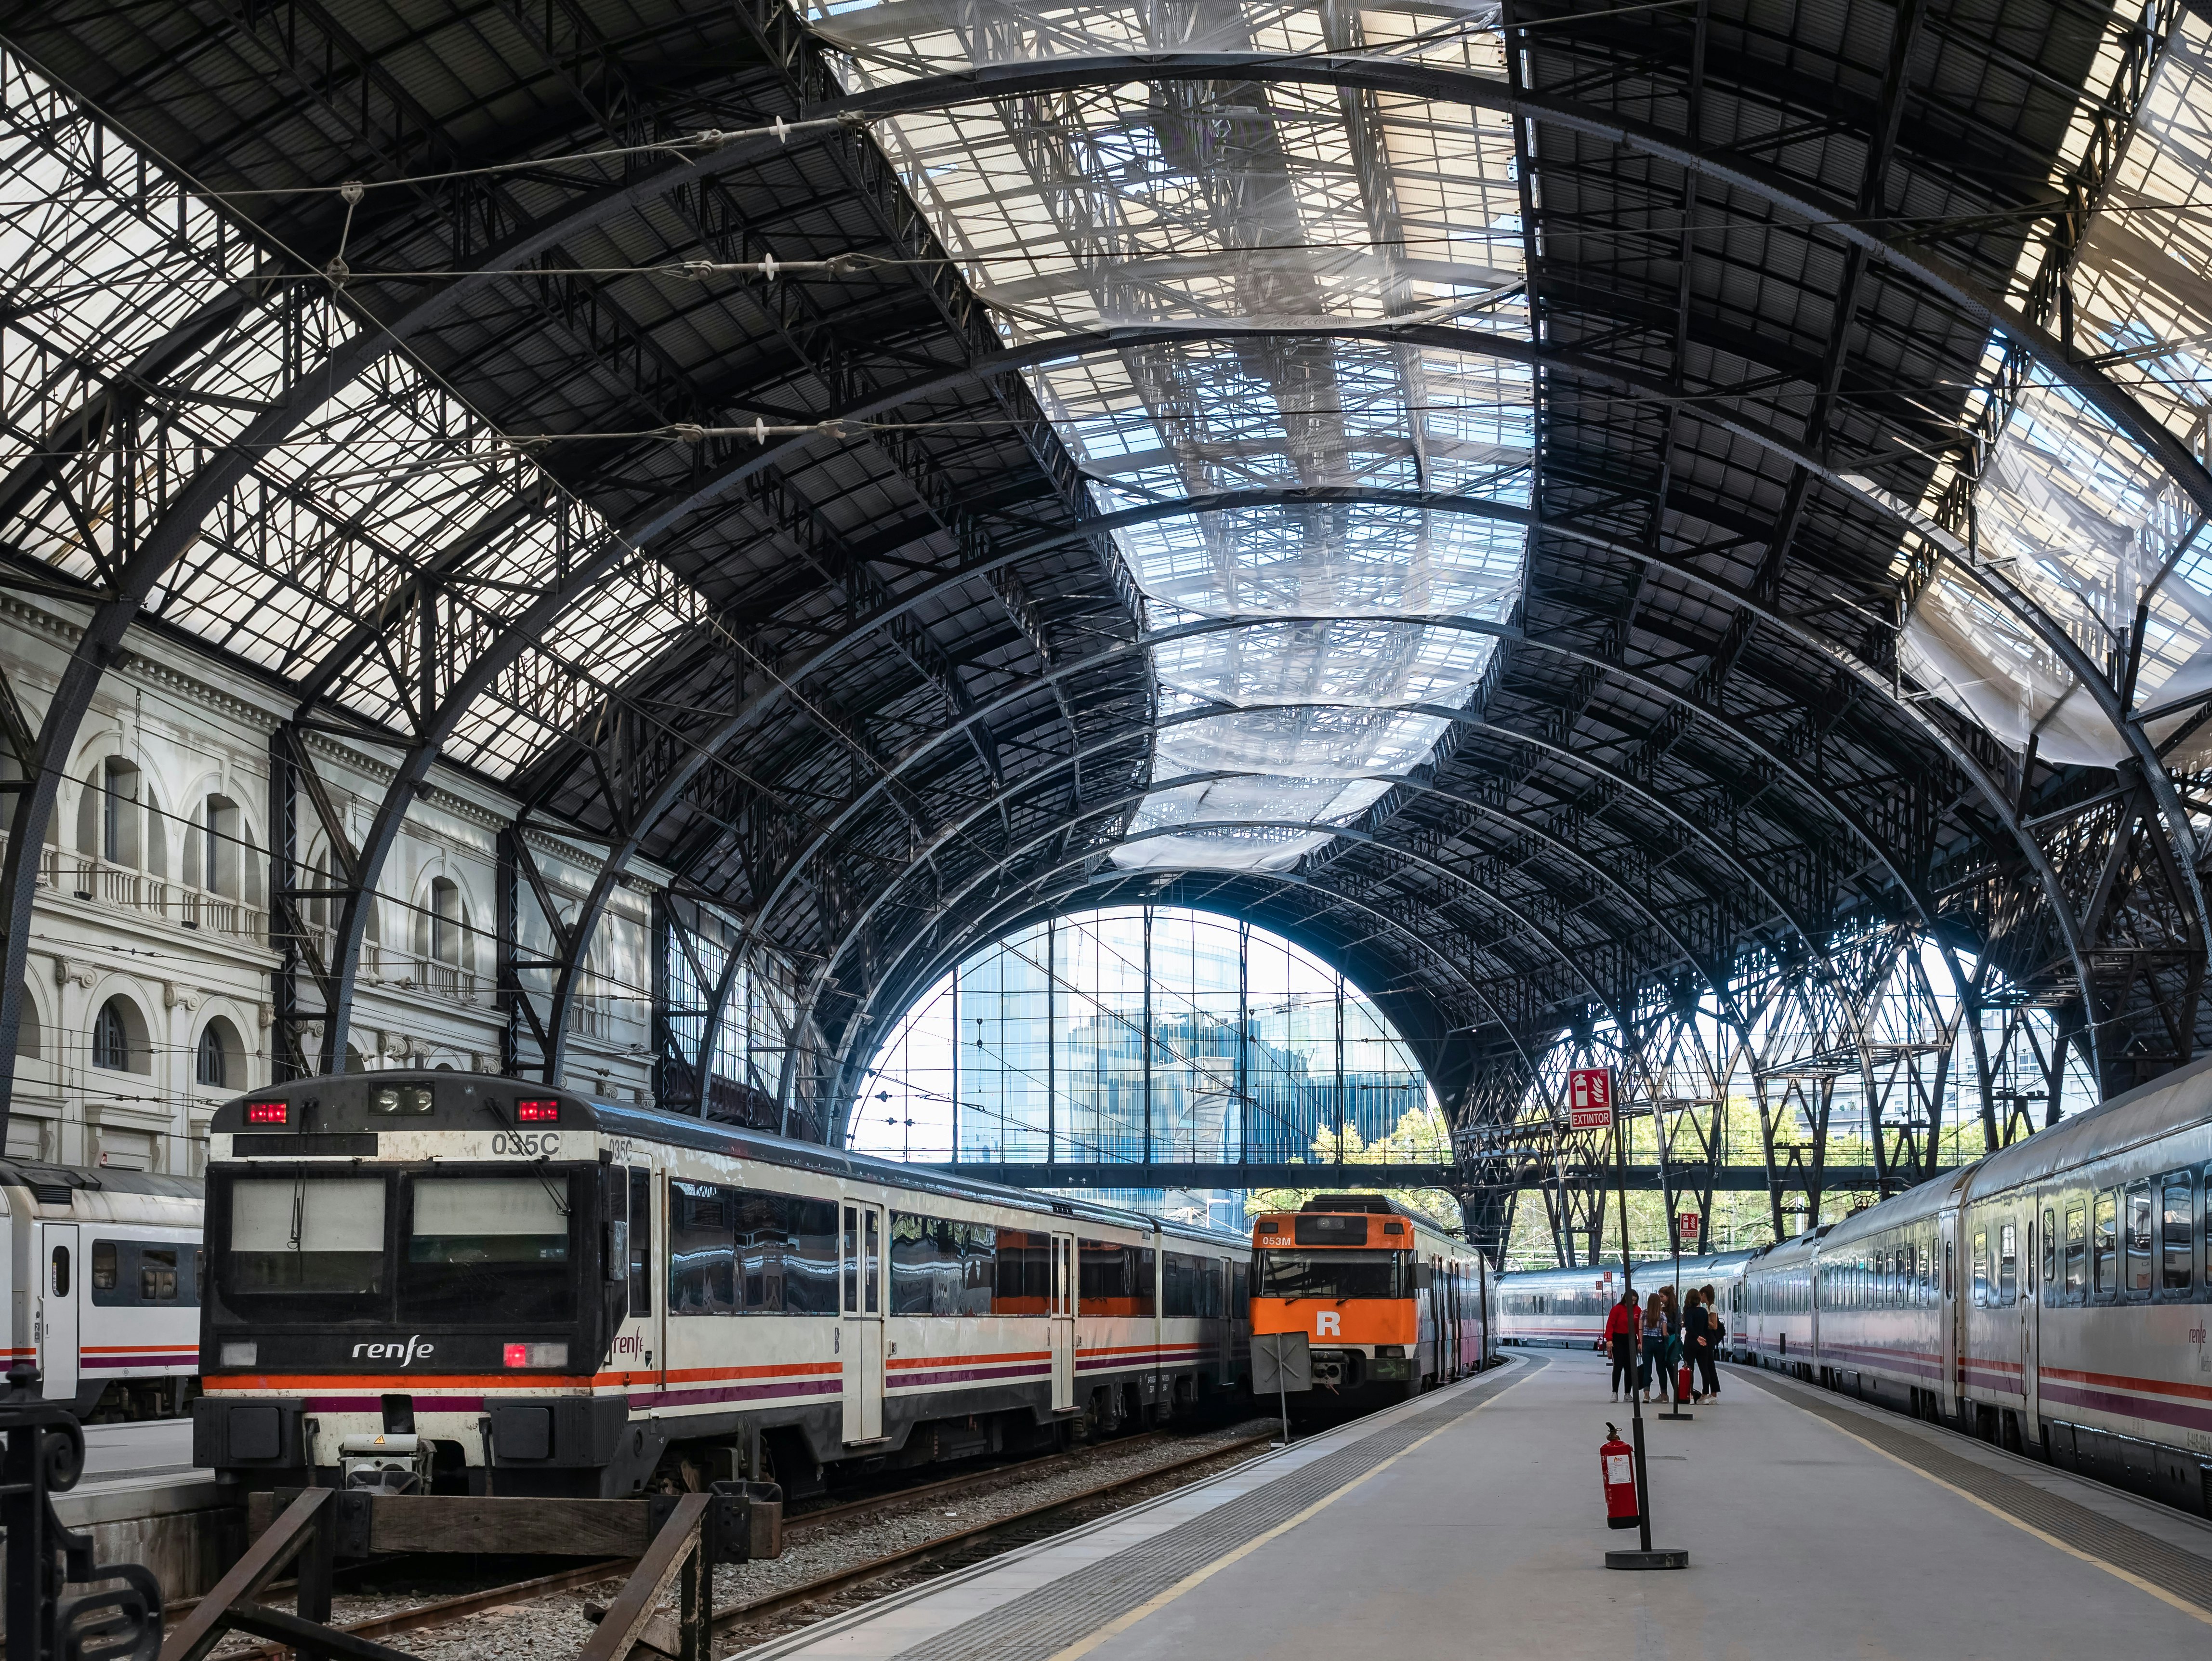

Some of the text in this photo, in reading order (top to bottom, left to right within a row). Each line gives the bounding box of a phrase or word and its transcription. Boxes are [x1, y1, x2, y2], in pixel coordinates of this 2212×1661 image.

[1573, 1113, 1609, 1125] EXTINTOR
[492, 1133, 559, 1155] 035C
[609, 1138, 632, 1162] 035C
[1263, 1236, 1291, 1246] 053M
[1317, 1311, 1341, 1336] R
[2189, 1319, 2206, 1354] renfe
[352, 1334, 434, 1368] renfe
